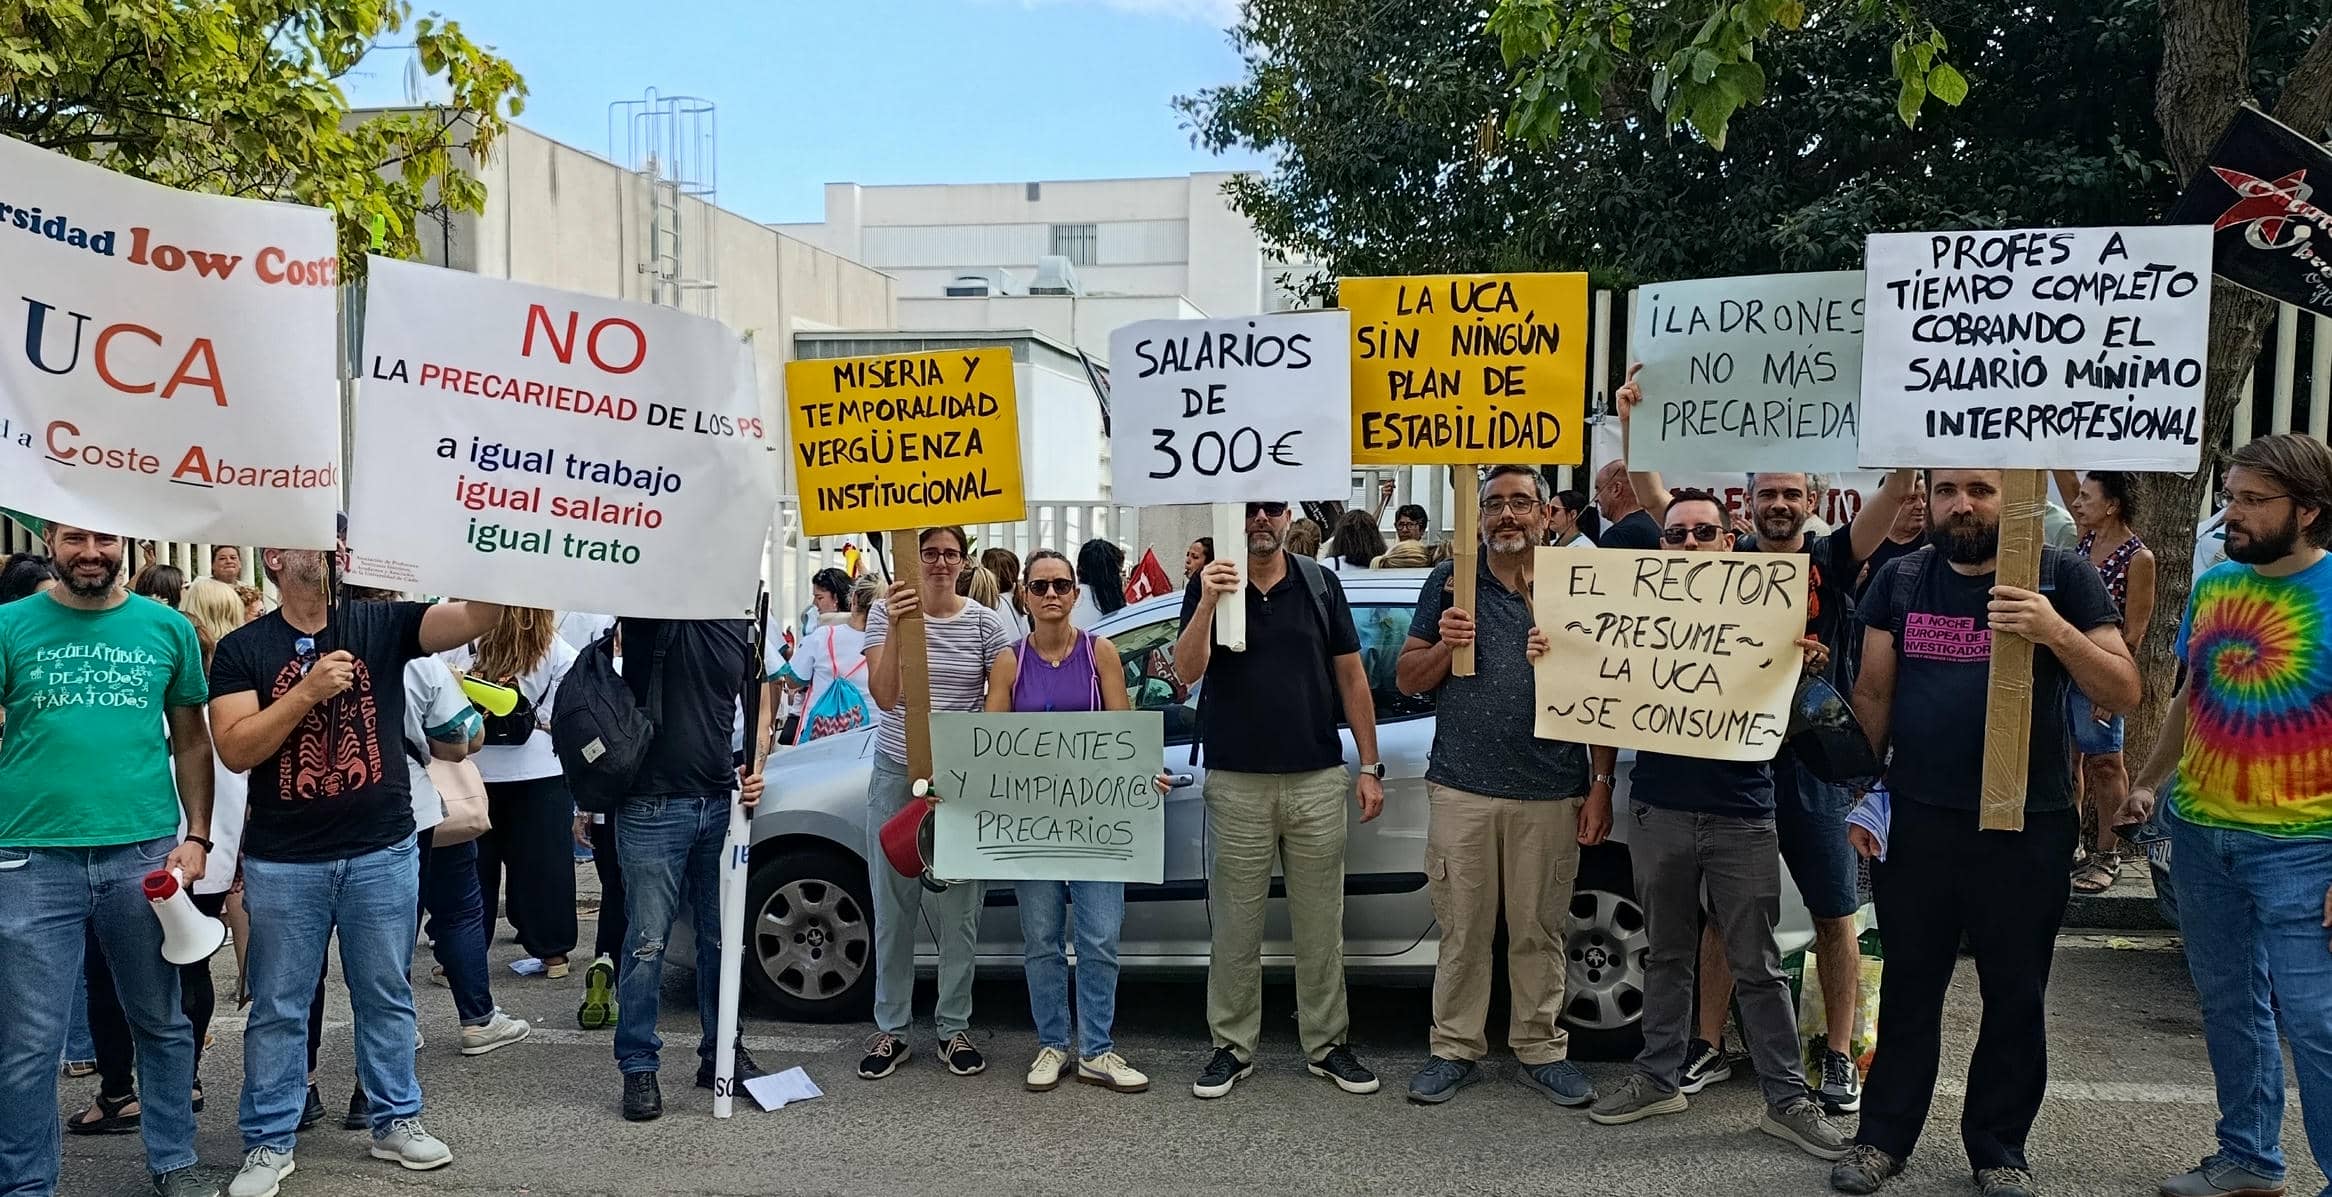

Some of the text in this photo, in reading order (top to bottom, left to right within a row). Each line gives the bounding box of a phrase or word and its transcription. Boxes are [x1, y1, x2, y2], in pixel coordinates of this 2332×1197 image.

[0, 202, 115, 256] rsidad
[127, 227, 242, 280] low
[1932, 231, 2128, 272] PROFES A
[1397, 281, 1519, 316] LA UCA
[1887, 262, 2199, 311] TIEMPO COMPLETO
[21, 296, 228, 407] UCA
[521, 303, 647, 375] NO
[1135, 321, 1312, 378] SALARIOS
[1357, 310, 1560, 359] SIN NINGÚN
[1912, 312, 2156, 348] COBRANDO EL
[833, 355, 980, 393] MISERIA Y
[1388, 366, 1527, 401] PLAN DE
[1690, 343, 1837, 389] NO MÁS
[1904, 348, 2201, 392] SALARIO MÍNIMO
[372, 355, 409, 384] LA
[419, 363, 638, 422] PRECARIEDAD
[646, 402, 687, 430] DE
[694, 411, 734, 436] LOS
[1181, 384, 1227, 418] DE
[1361, 405, 1561, 449] ESTABILIDAD
[1661, 399, 1856, 442] PRECARIEDA
[1926, 393, 2199, 445] INTERPROFESIONAL
[18, 433, 31, 448] a
[46, 420, 160, 474] Coste
[436, 436, 682, 497] a igual trabajo
[799, 427, 983, 468] VERGÜENZA
[1149, 425, 1304, 480] 300€
[455, 475, 664, 530] igual salario
[817, 467, 1002, 512] INSTITUCIONAL
[466, 518, 642, 566] igual trato
[1568, 556, 1796, 610] EL RECTOR
[1906, 628, 1992, 642] EUROPEA DE L
[1908, 614, 1970, 629] LA NOCHE
[1599, 656, 1723, 696] LA UCA
[973, 727, 1136, 761] DOCENTES
[950, 769, 967, 798] Y
[975, 810, 1134, 845] PRECARIOS
